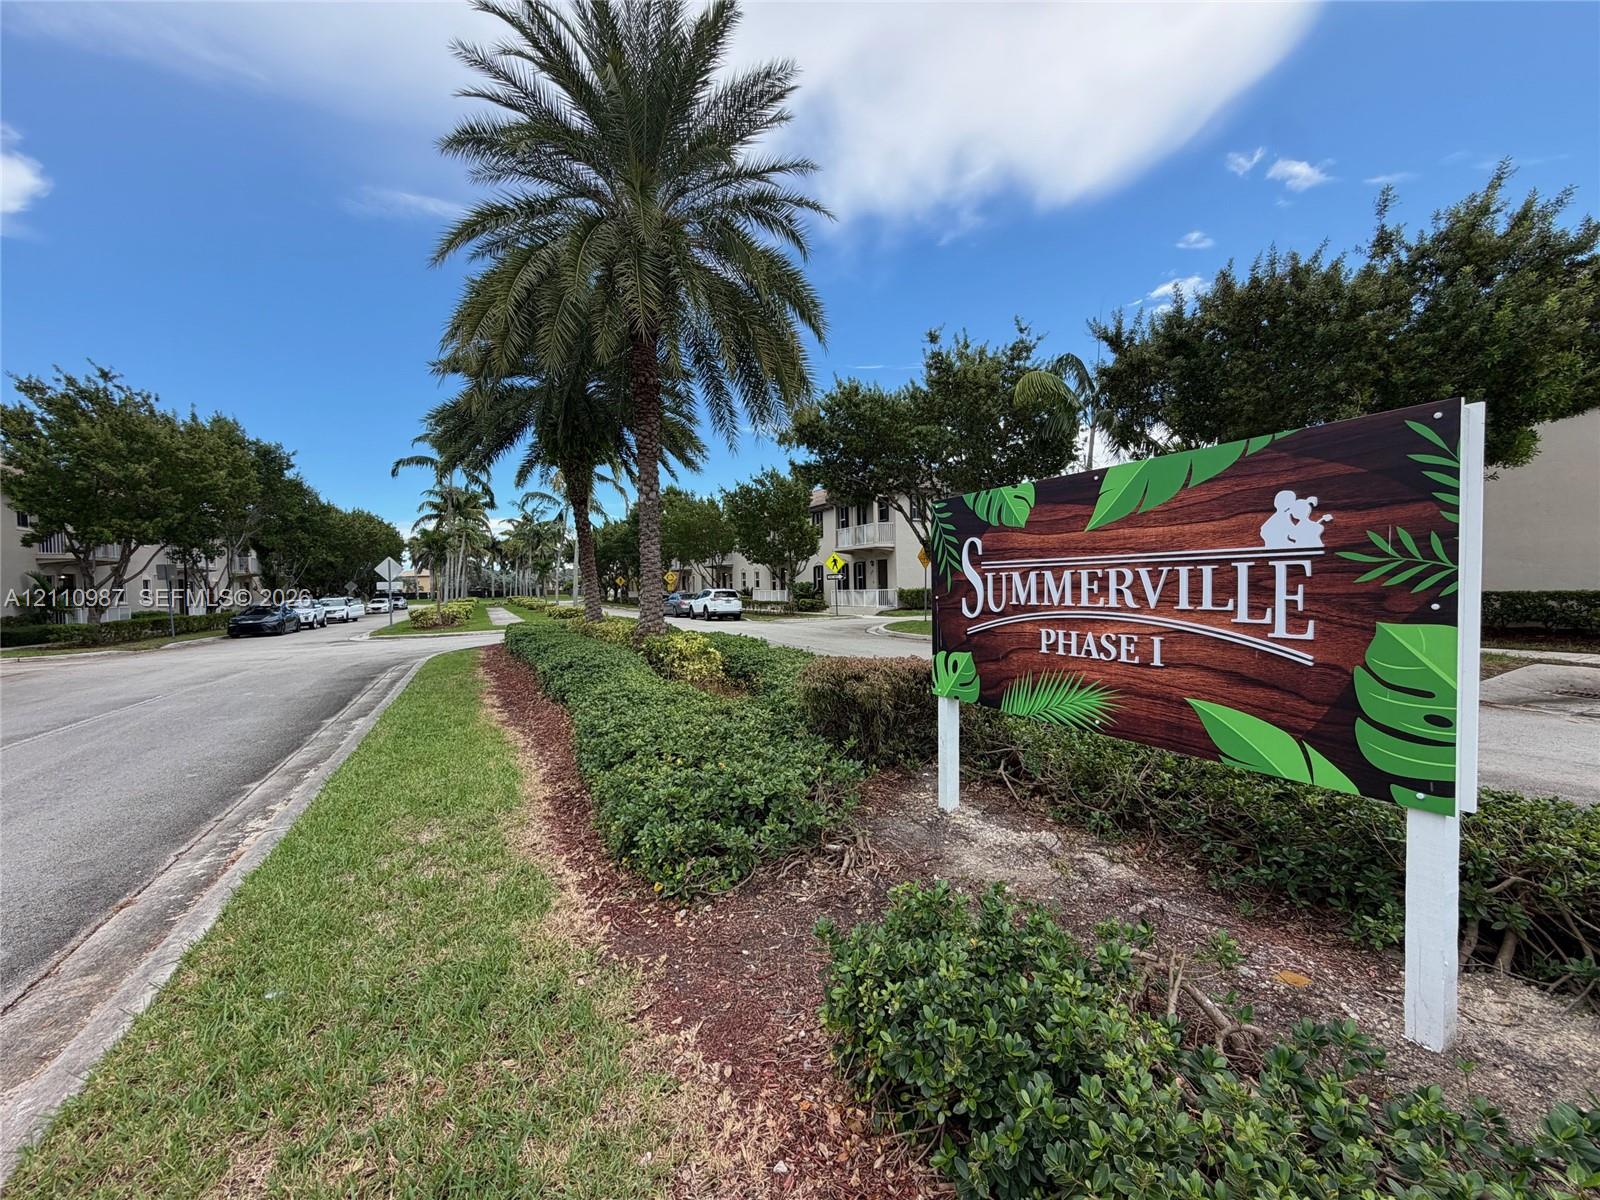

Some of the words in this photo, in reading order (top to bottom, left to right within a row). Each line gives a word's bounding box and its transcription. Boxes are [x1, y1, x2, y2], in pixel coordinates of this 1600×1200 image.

[961, 537, 1314, 640] SUMMERVILLE
[1039, 628, 1140, 664] PHASE
[1151, 636, 1165, 667] I
